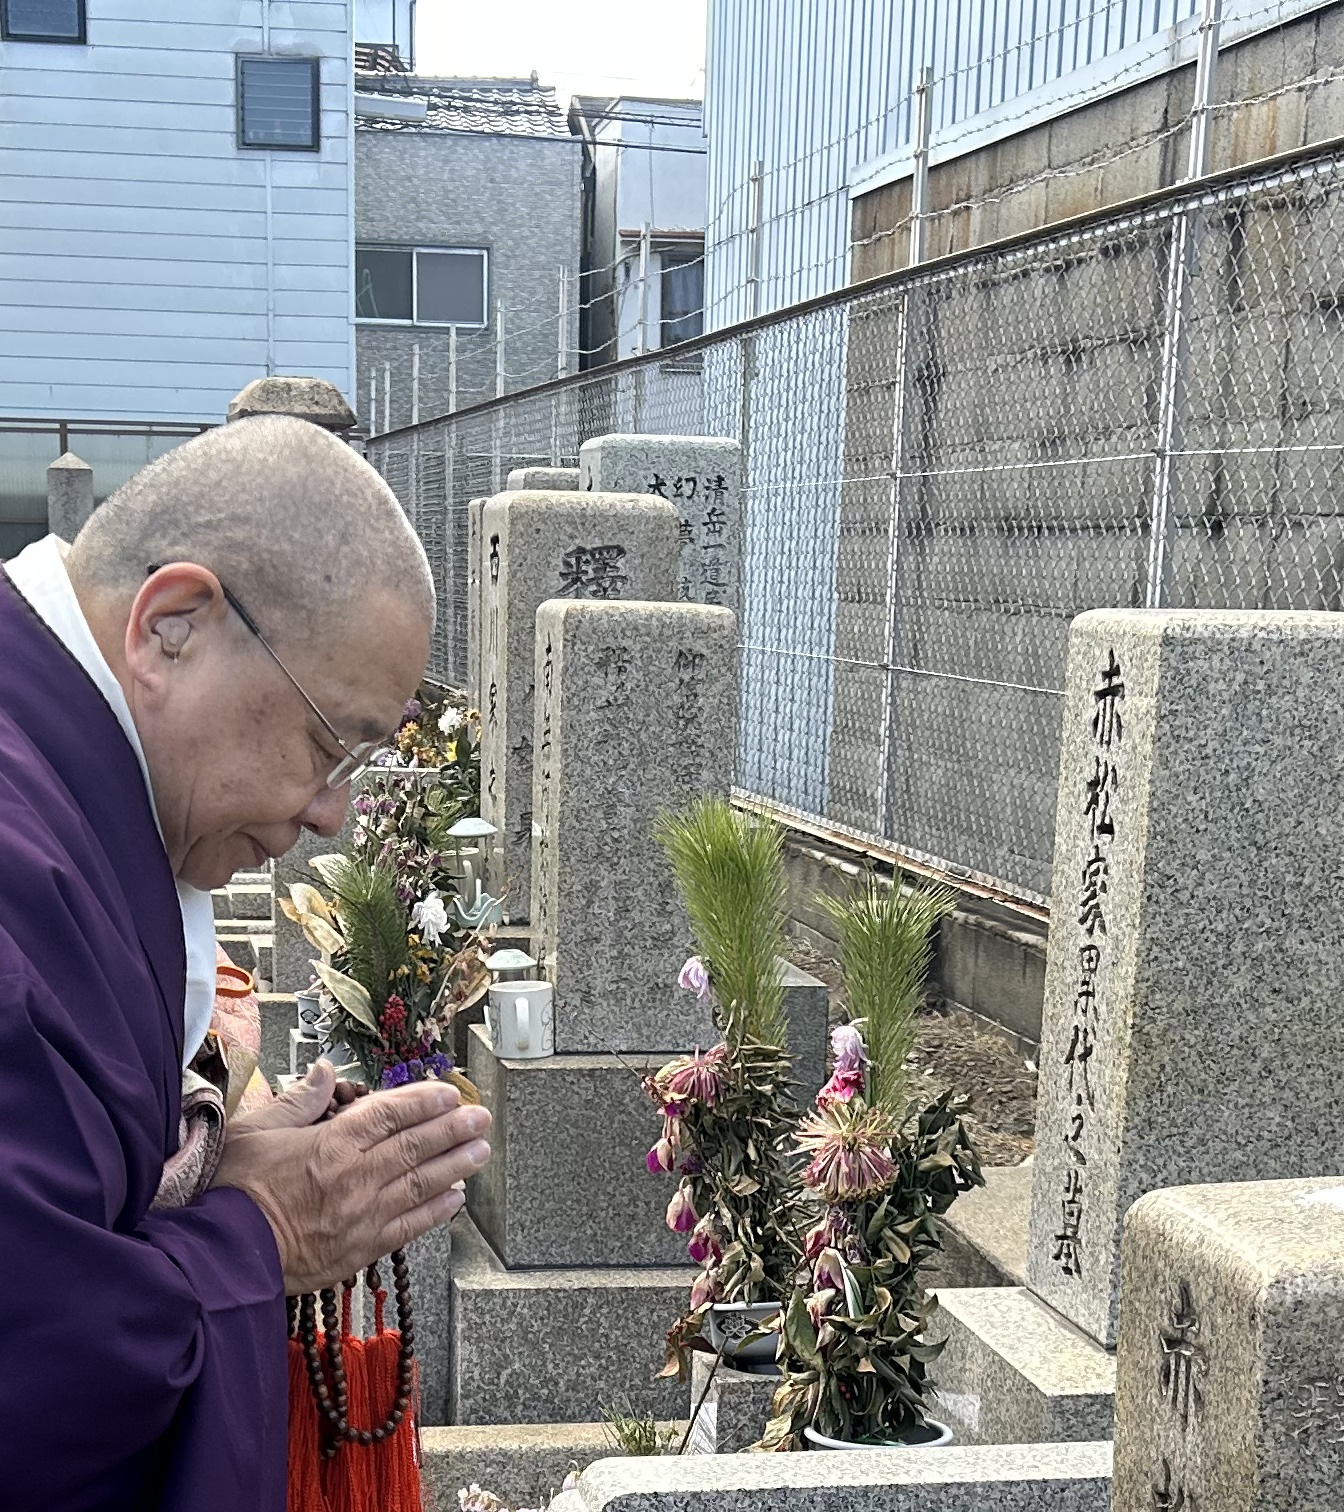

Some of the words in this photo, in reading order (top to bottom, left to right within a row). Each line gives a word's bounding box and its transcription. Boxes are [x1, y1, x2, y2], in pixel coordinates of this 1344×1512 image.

[1052, 648, 1126, 1279] 赤松家累代之墓
